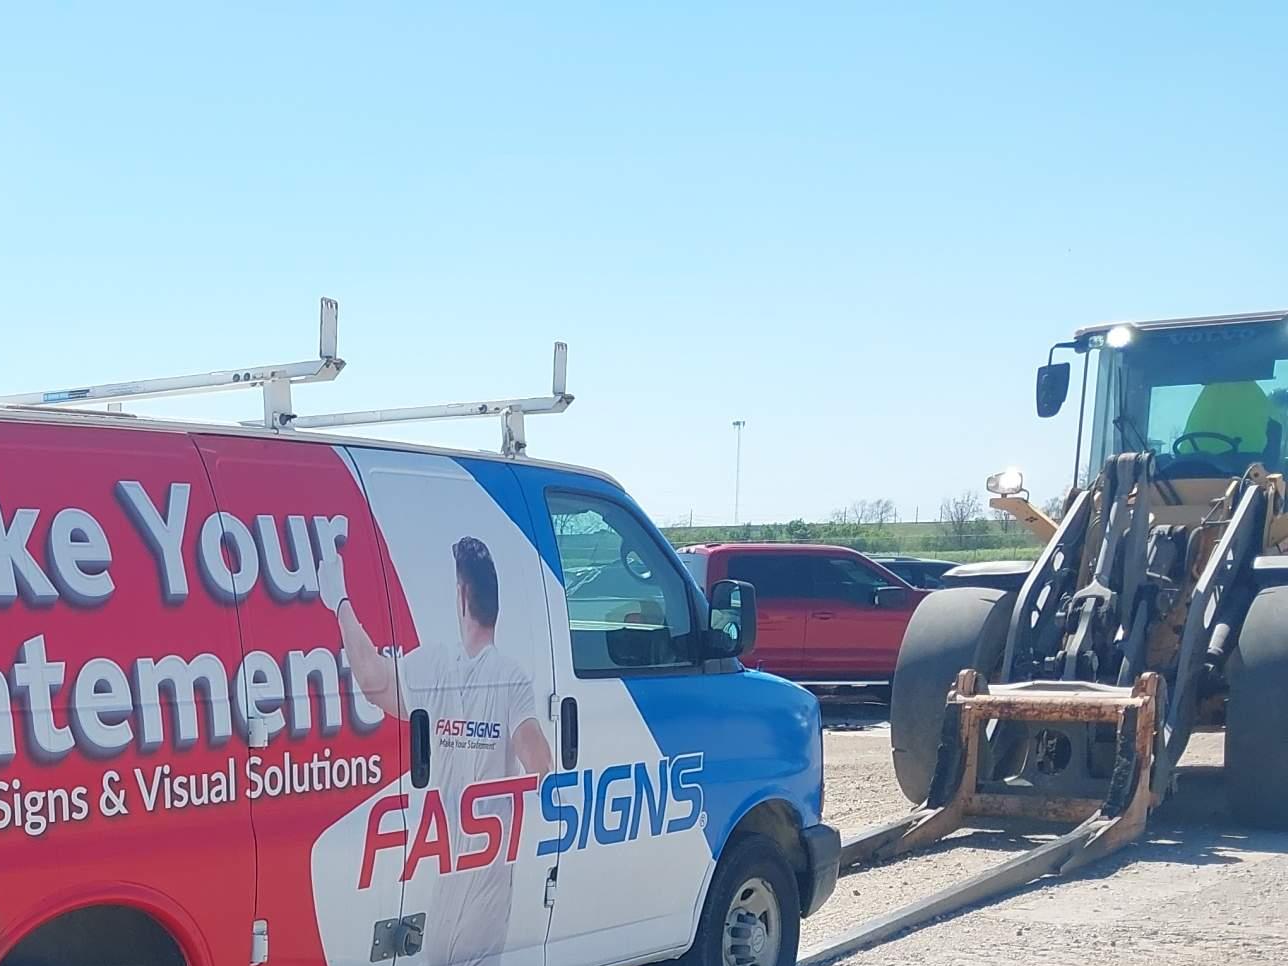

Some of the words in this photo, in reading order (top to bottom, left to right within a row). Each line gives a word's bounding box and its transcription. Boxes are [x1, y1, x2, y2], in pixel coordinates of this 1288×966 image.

[1168, 328, 1257, 345] VOLVO
[116, 481, 348, 598] Your
[435, 719, 501, 738] FASTSIGNS
[439, 738, 454, 748] Make
[455, 740, 467, 749] Your
[467, 740, 495, 750] Statement
[99, 771, 128, 819] &
[134, 757, 237, 813] Visual
[245, 746, 383, 800] Solutions
